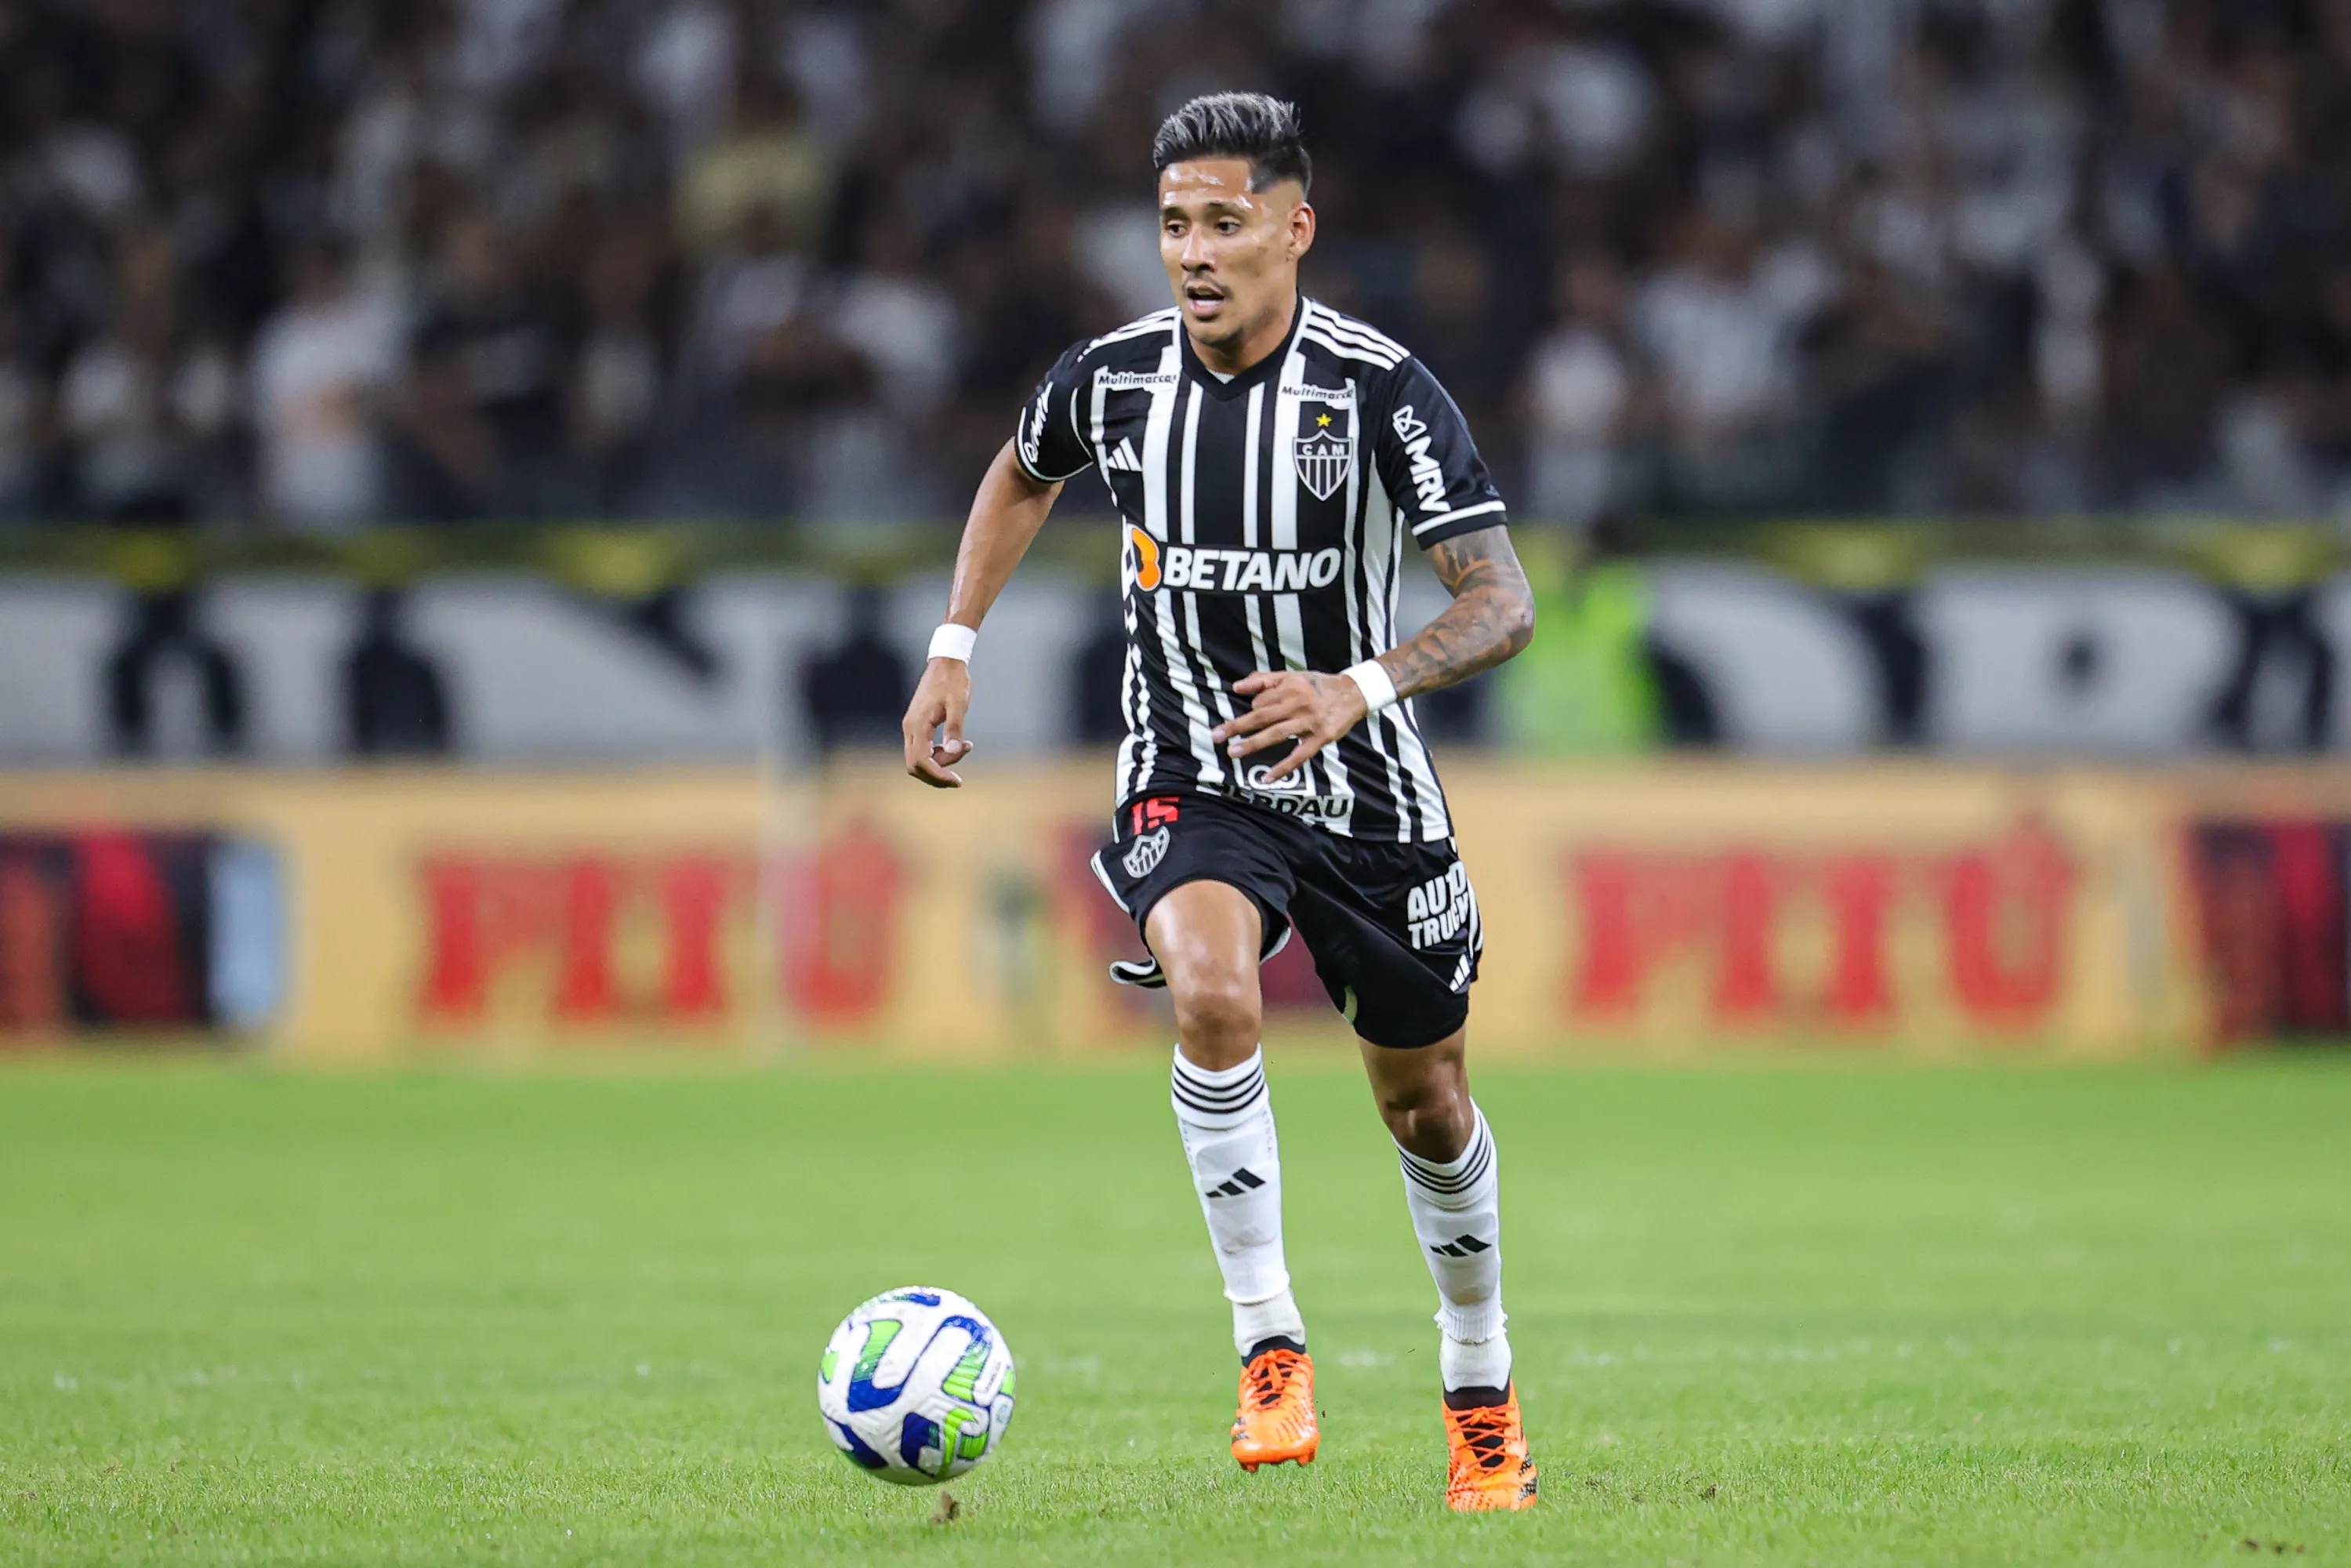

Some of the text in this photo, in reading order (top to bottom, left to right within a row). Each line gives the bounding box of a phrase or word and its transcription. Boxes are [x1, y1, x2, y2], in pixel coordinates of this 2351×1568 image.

[1302, 444, 1345, 456] CAM
[1405, 435, 1451, 512] MRV
[1163, 546, 1341, 591] BETANO
[1132, 797, 1180, 836] 15
[1407, 860, 1468, 923] AUTO
